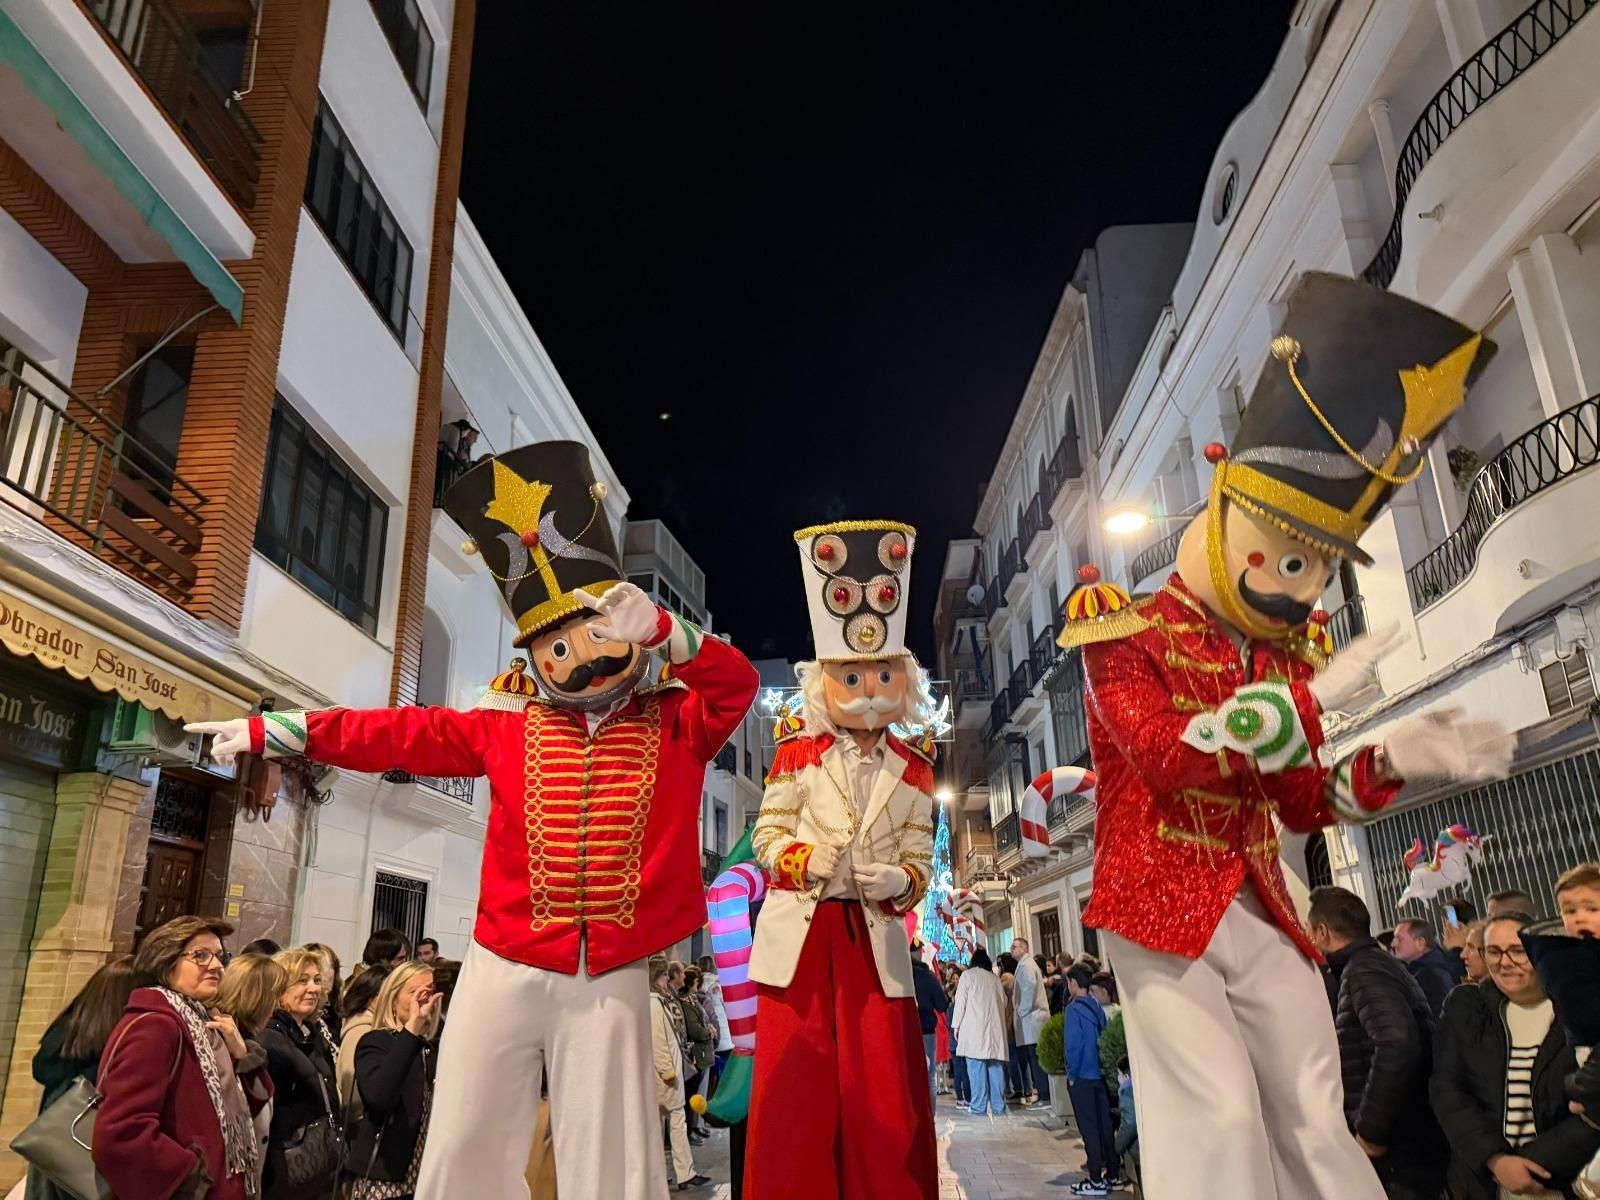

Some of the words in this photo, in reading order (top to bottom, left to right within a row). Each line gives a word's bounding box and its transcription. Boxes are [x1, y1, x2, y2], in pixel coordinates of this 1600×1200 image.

[91, 648, 137, 684] San
[139, 667, 178, 701] José
[0, 693, 22, 724] an
[24, 694, 76, 741] José
